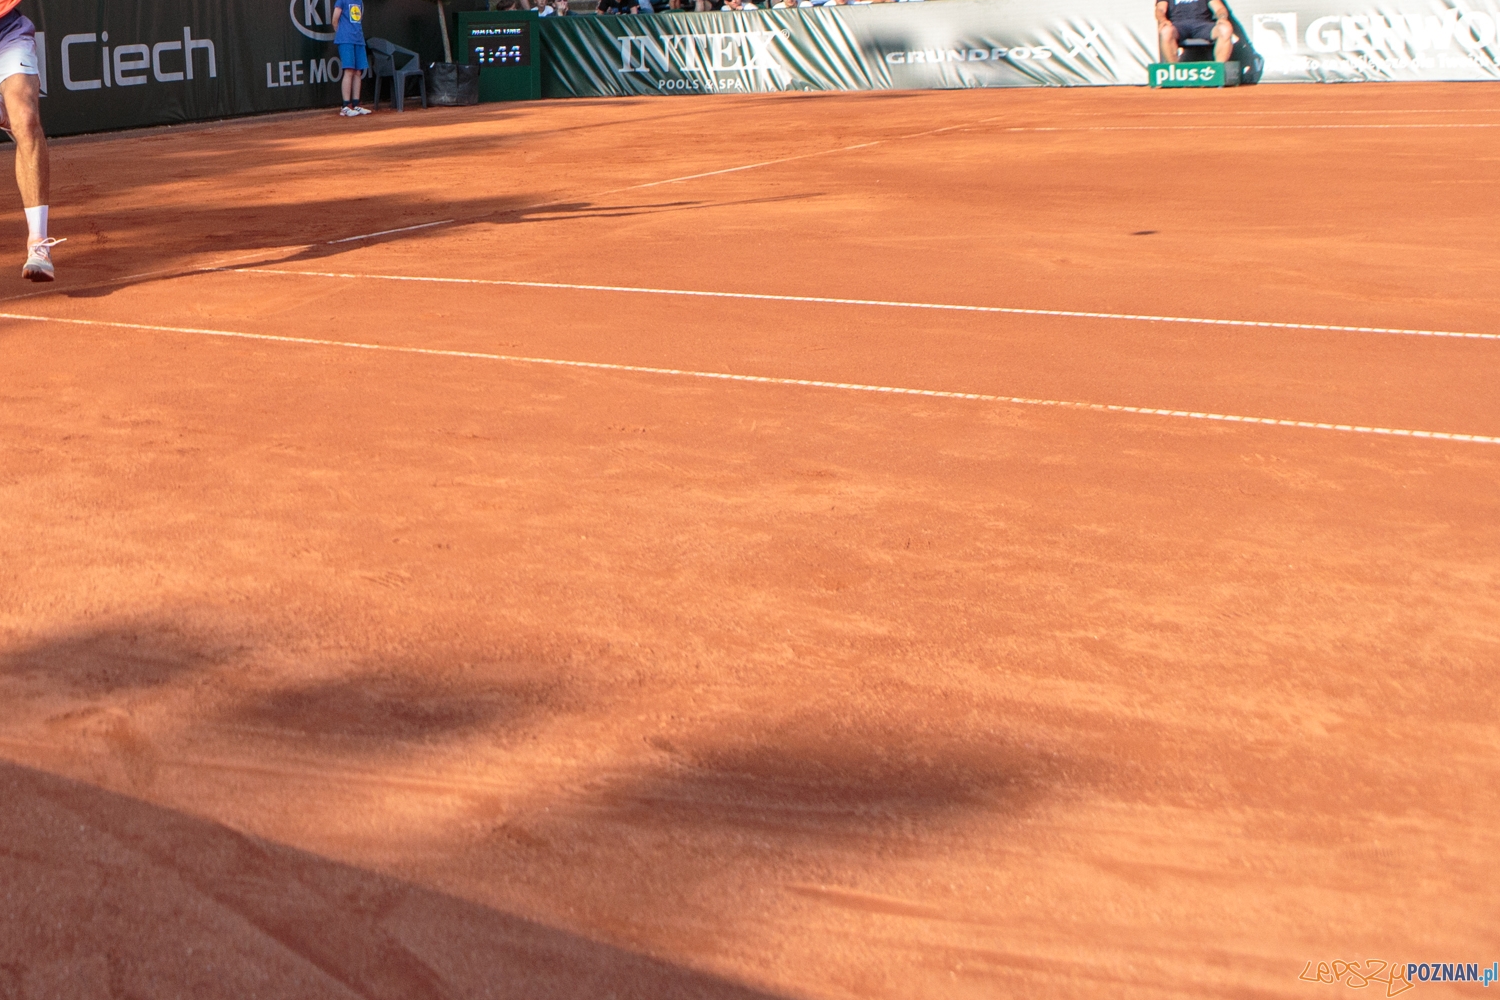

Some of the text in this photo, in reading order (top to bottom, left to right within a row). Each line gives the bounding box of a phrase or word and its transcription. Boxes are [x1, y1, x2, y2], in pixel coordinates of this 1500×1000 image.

[61, 26, 217, 91] Ciech
[885, 45, 1052, 65] GRUNDFOS
[266, 60, 304, 88] LEE
[1156, 65, 1198, 85] plus
[658, 79, 699, 90] POOLS
